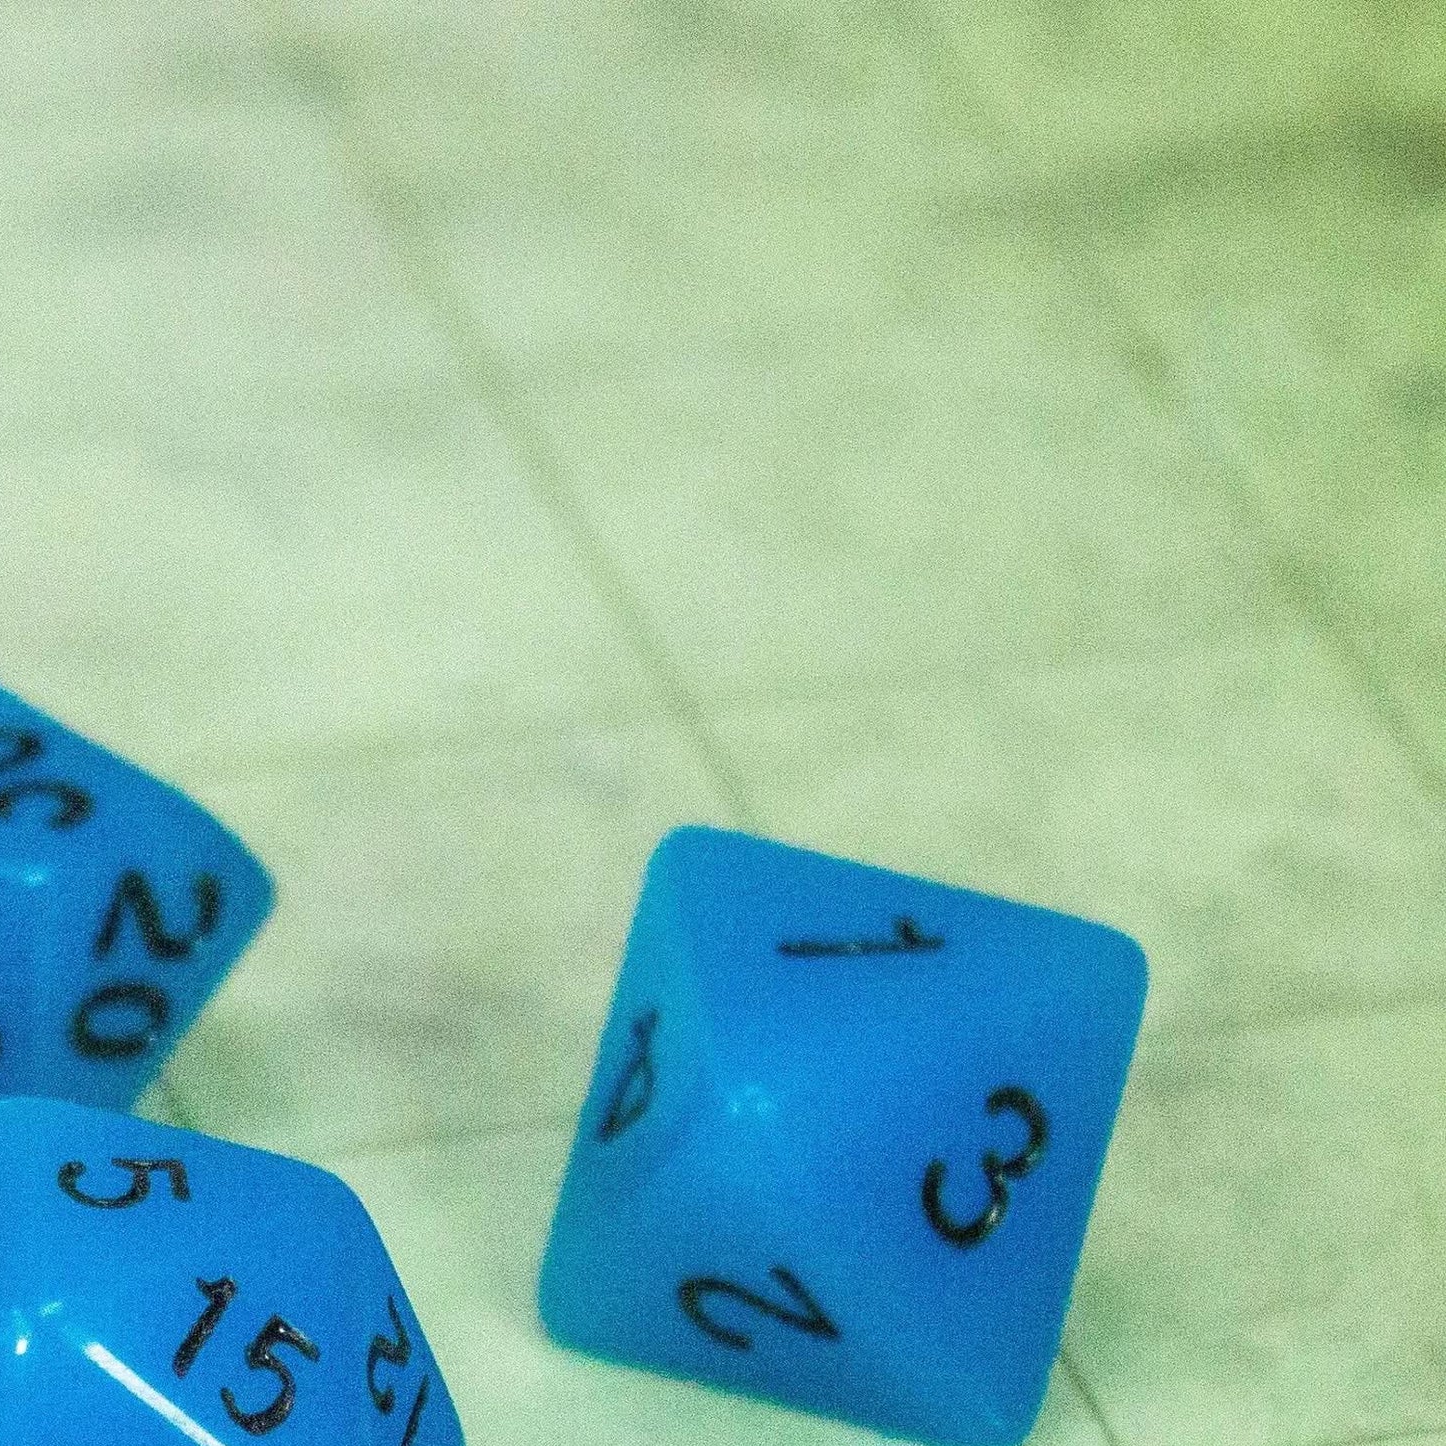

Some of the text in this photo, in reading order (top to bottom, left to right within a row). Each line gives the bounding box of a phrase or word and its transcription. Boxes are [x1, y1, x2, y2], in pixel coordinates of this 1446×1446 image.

[69, 872, 221, 1062] 20
[780, 918, 943, 956] 1
[58, 1159, 190, 1208] 5
[921, 1087, 1048, 1249] 3
[174, 1278, 318, 1435] 15
[678, 1268, 839, 1351] 2
